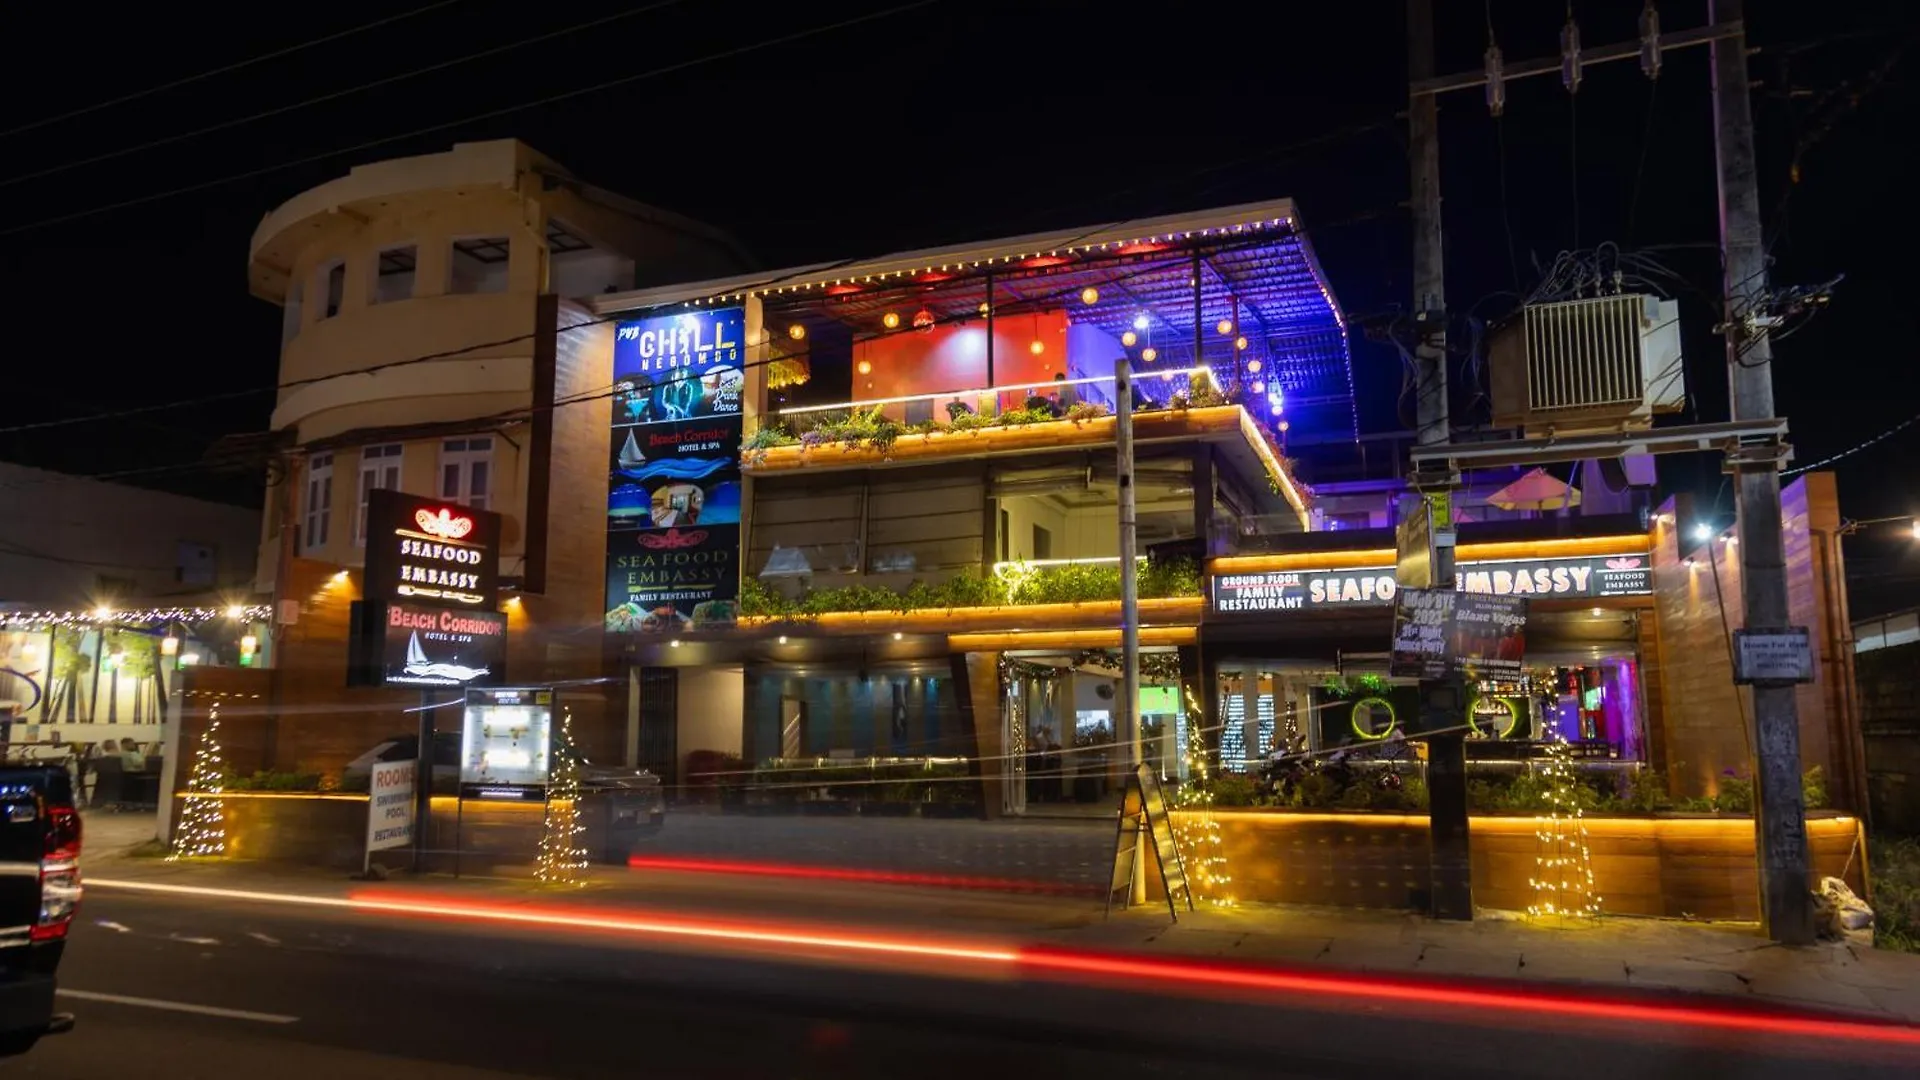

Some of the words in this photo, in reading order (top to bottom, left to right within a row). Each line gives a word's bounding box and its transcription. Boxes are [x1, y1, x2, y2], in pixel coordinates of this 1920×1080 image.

[617, 326, 640, 341] PUB
[713, 400, 738, 412] Dance
[401, 540, 482, 565] SEAFOOD
[401, 565, 479, 590] EMBASSY
[628, 567, 726, 584] EMBASSY
[1222, 576, 1264, 586] GROUND
[1267, 574, 1299, 584] FLOOR
[1604, 572, 1645, 581] SEAFOOD
[1236, 585, 1285, 598] FAMILY
[1309, 576, 1396, 603] SEAFO
[1605, 580, 1645, 589] EMBASSY
[630, 593, 657, 602] FAMILY
[660, 591, 713, 601] RESTAURANT
[1219, 597, 1304, 611] RESTAURANT
[389, 606, 437, 630] BEACH
[440, 611, 502, 636] CORRIDOR
[1413, 608, 1443, 625] 2023
